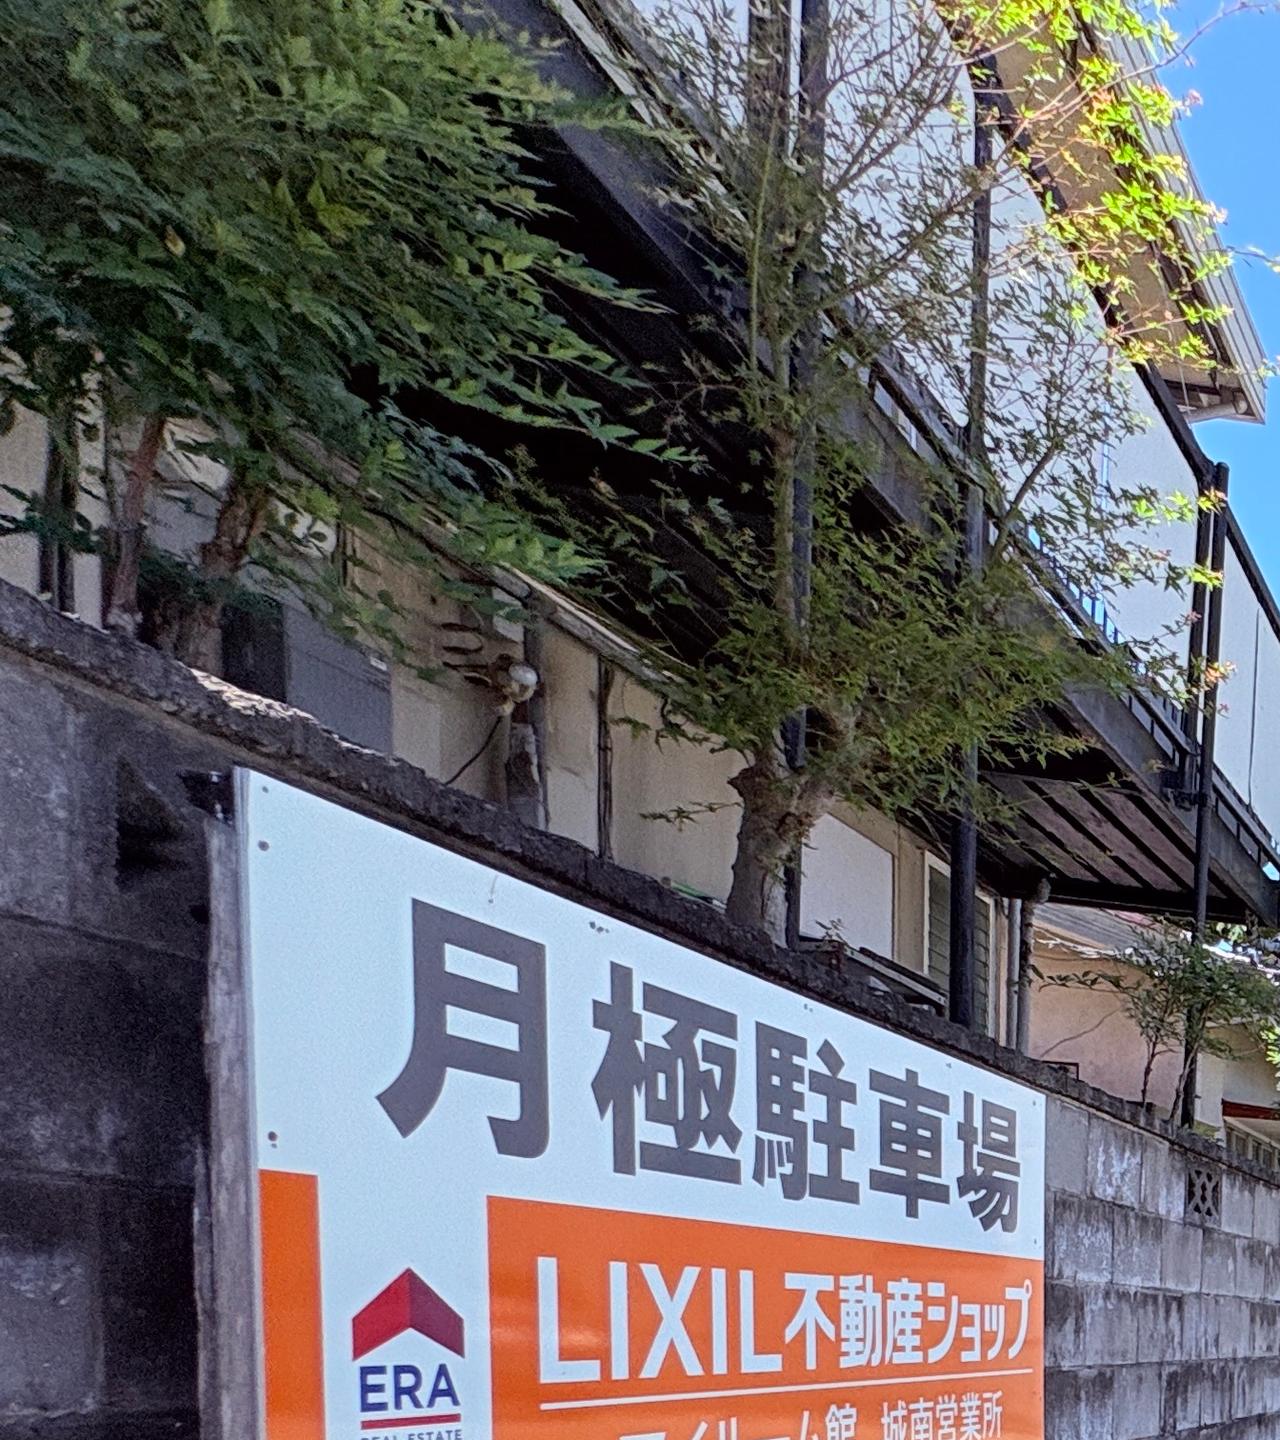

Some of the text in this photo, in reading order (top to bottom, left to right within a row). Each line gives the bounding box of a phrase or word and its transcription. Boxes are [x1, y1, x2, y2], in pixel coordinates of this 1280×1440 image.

[375, 897, 1021, 1233] 月極駐車場
[537, 1256, 1033, 1384] LIXIL不動産ショップ
[359, 1363, 461, 1413] ERA
